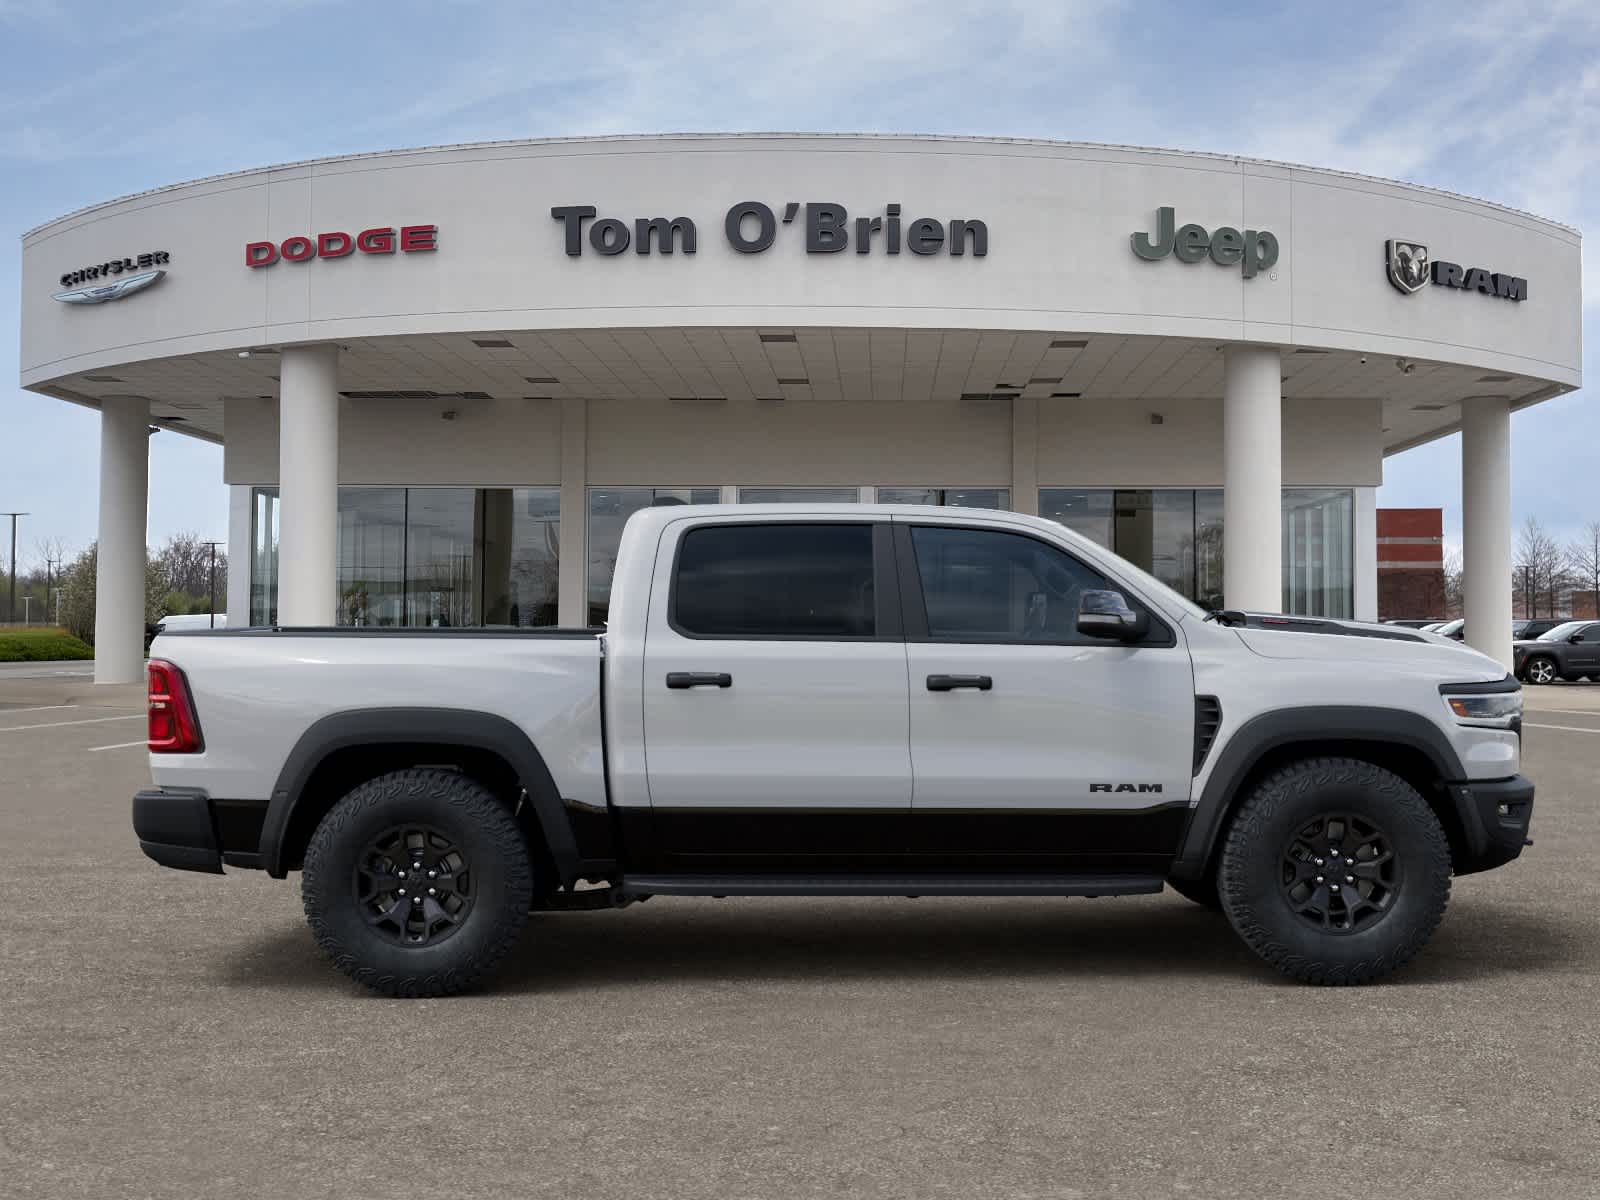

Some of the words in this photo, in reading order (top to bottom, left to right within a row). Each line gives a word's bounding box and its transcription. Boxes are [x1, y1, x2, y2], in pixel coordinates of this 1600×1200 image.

[245, 224, 438, 269] DODGE
[551, 205, 697, 256] Tom
[725, 201, 988, 256] O'Brien
[1130, 206, 1279, 279] Jeep
[60, 250, 170, 287] CHRYSLER
[1431, 260, 1528, 302] RAM
[1089, 783, 1163, 793] RAM
